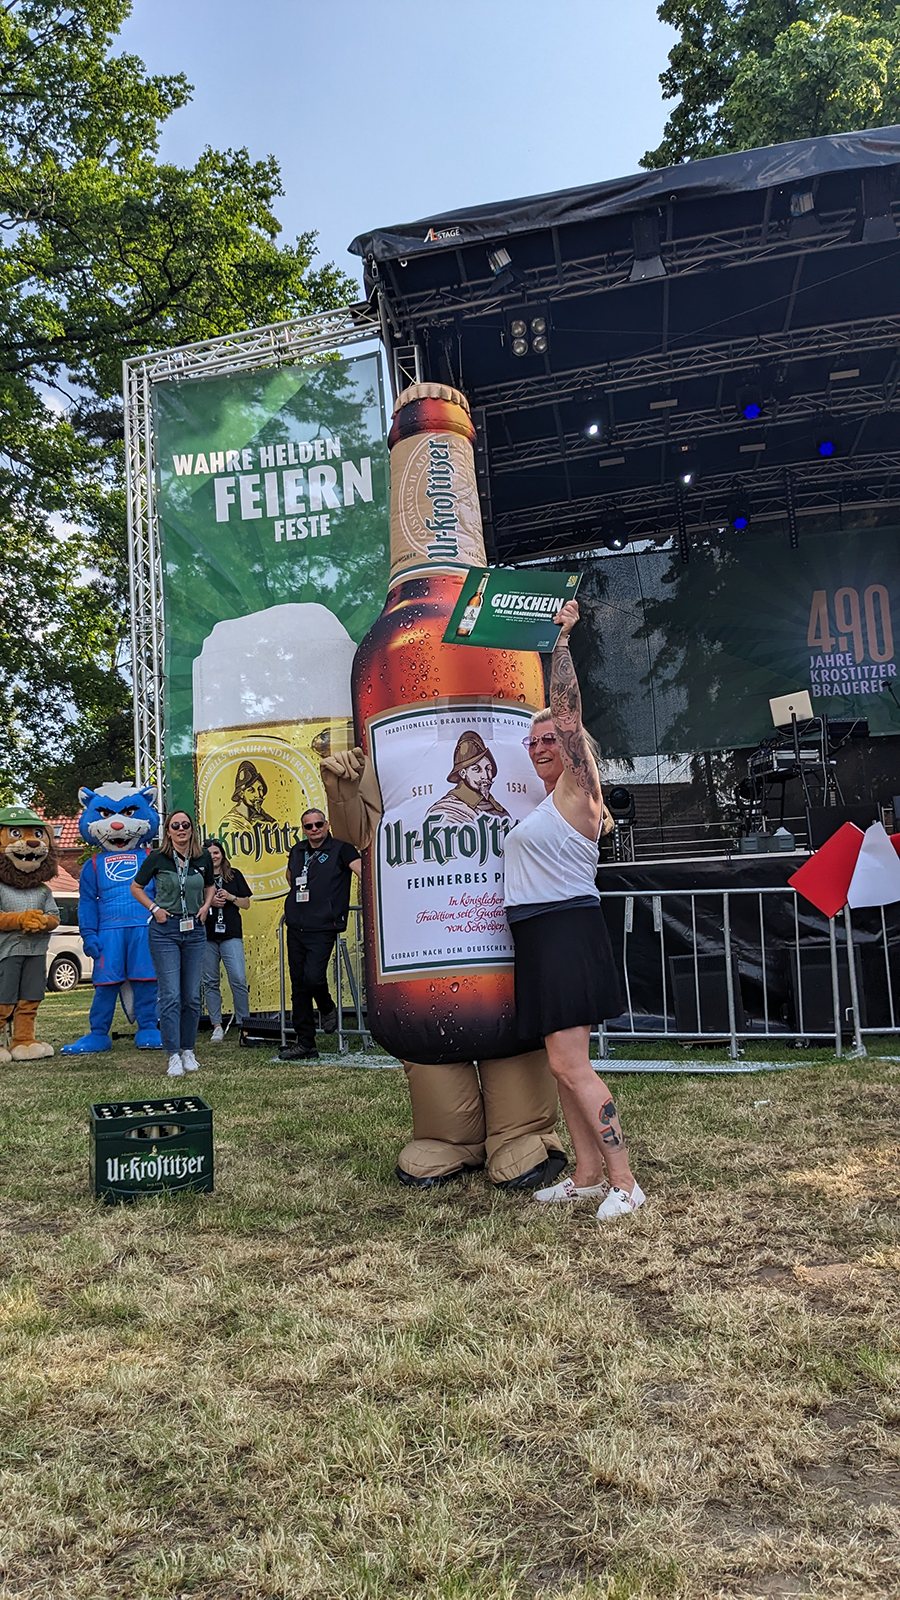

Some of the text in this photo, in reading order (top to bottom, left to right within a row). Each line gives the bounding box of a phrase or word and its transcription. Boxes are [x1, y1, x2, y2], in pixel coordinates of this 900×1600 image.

[437, 229, 460, 240] STAGE
[172, 436, 341, 477] WAHRE HELDEN
[213, 457, 374, 523] FEIERN
[274, 514, 332, 543] FESTE
[491, 593, 564, 613] GUTSCHEIN
[807, 584, 895, 664] 490
[809, 653, 853, 669] JAHRE
[810, 663, 898, 683] KROSTITZER
[811, 680, 885, 698] BRAUEREI
[384, 719, 438, 736] TRADITIONELLES
[440, 716, 501, 726] BRAUHANDWERK
[503, 718, 515, 726] AUS
[227, 744, 306, 774] BRAUHANDWERK
[305, 772, 317, 793] SEIT
[412, 782, 527, 797] SEIT 1534
[407, 872, 487, 889] FEINHERBES
[448, 892, 505, 909] In königlicher
[415, 909, 456, 925] Tradition
[456, 907, 476, 919] seit
[444, 918, 507, 936] von Schweden
[391, 951, 419, 960] GEBRAUT
[422, 948, 443, 956] NACH
[446, 947, 463, 955] DEM
[467, 944, 507, 953] DEUTSCHEN
